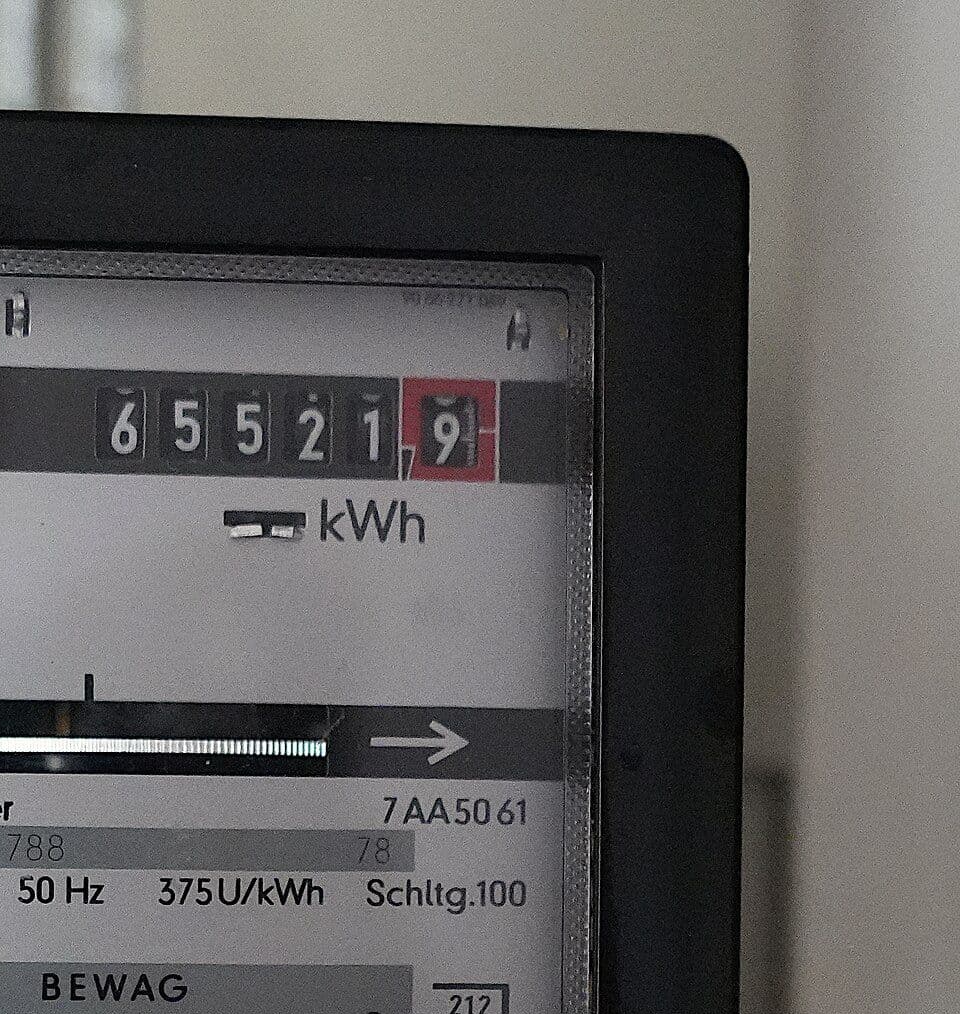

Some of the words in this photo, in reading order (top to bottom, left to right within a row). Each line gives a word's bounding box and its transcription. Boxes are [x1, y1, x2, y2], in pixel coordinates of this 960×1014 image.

[319, 499, 426, 544] kWh
[7, 833, 65, 862] 788
[356, 836, 391, 864] 78
[17, 876, 55, 904] 50
[66, 876, 104, 905] Hz
[41, 972, 189, 1003] BEWAG
